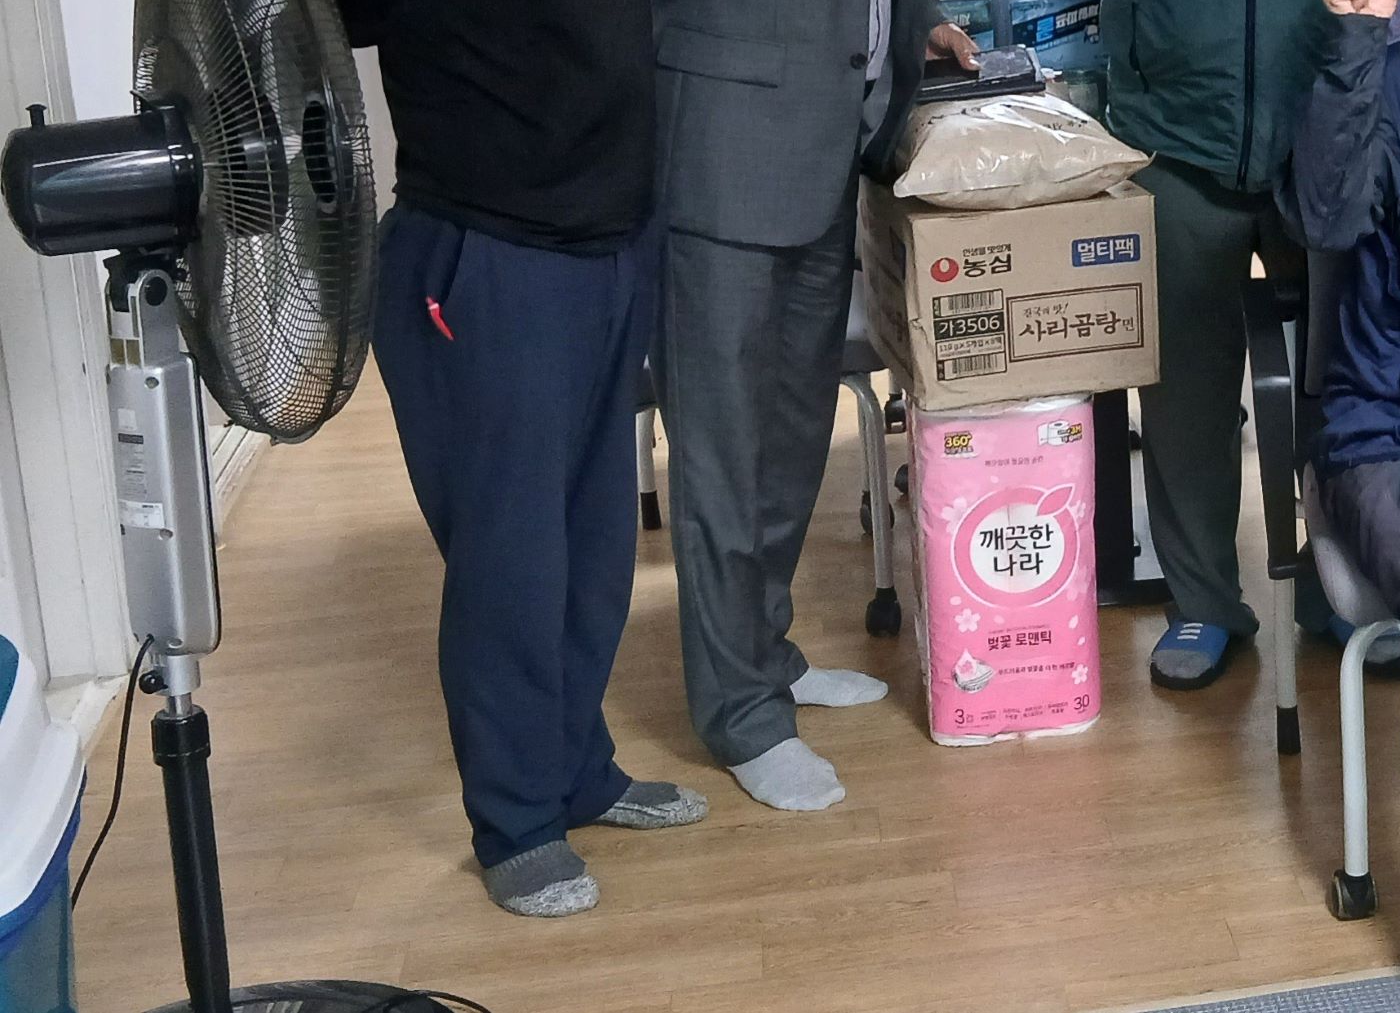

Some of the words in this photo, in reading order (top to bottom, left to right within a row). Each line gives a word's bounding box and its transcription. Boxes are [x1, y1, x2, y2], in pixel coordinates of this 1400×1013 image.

[1077, 237, 1134, 263] 멀티팩
[962, 253, 1012, 278] 농심
[939, 314, 1001, 337] 가3506
[979, 523, 1055, 551] 깨끗한
[993, 551, 1044, 577] 나라
[987, 634, 1012, 652] 벚꽃
[1014, 629, 1052, 647] 로맨틱
